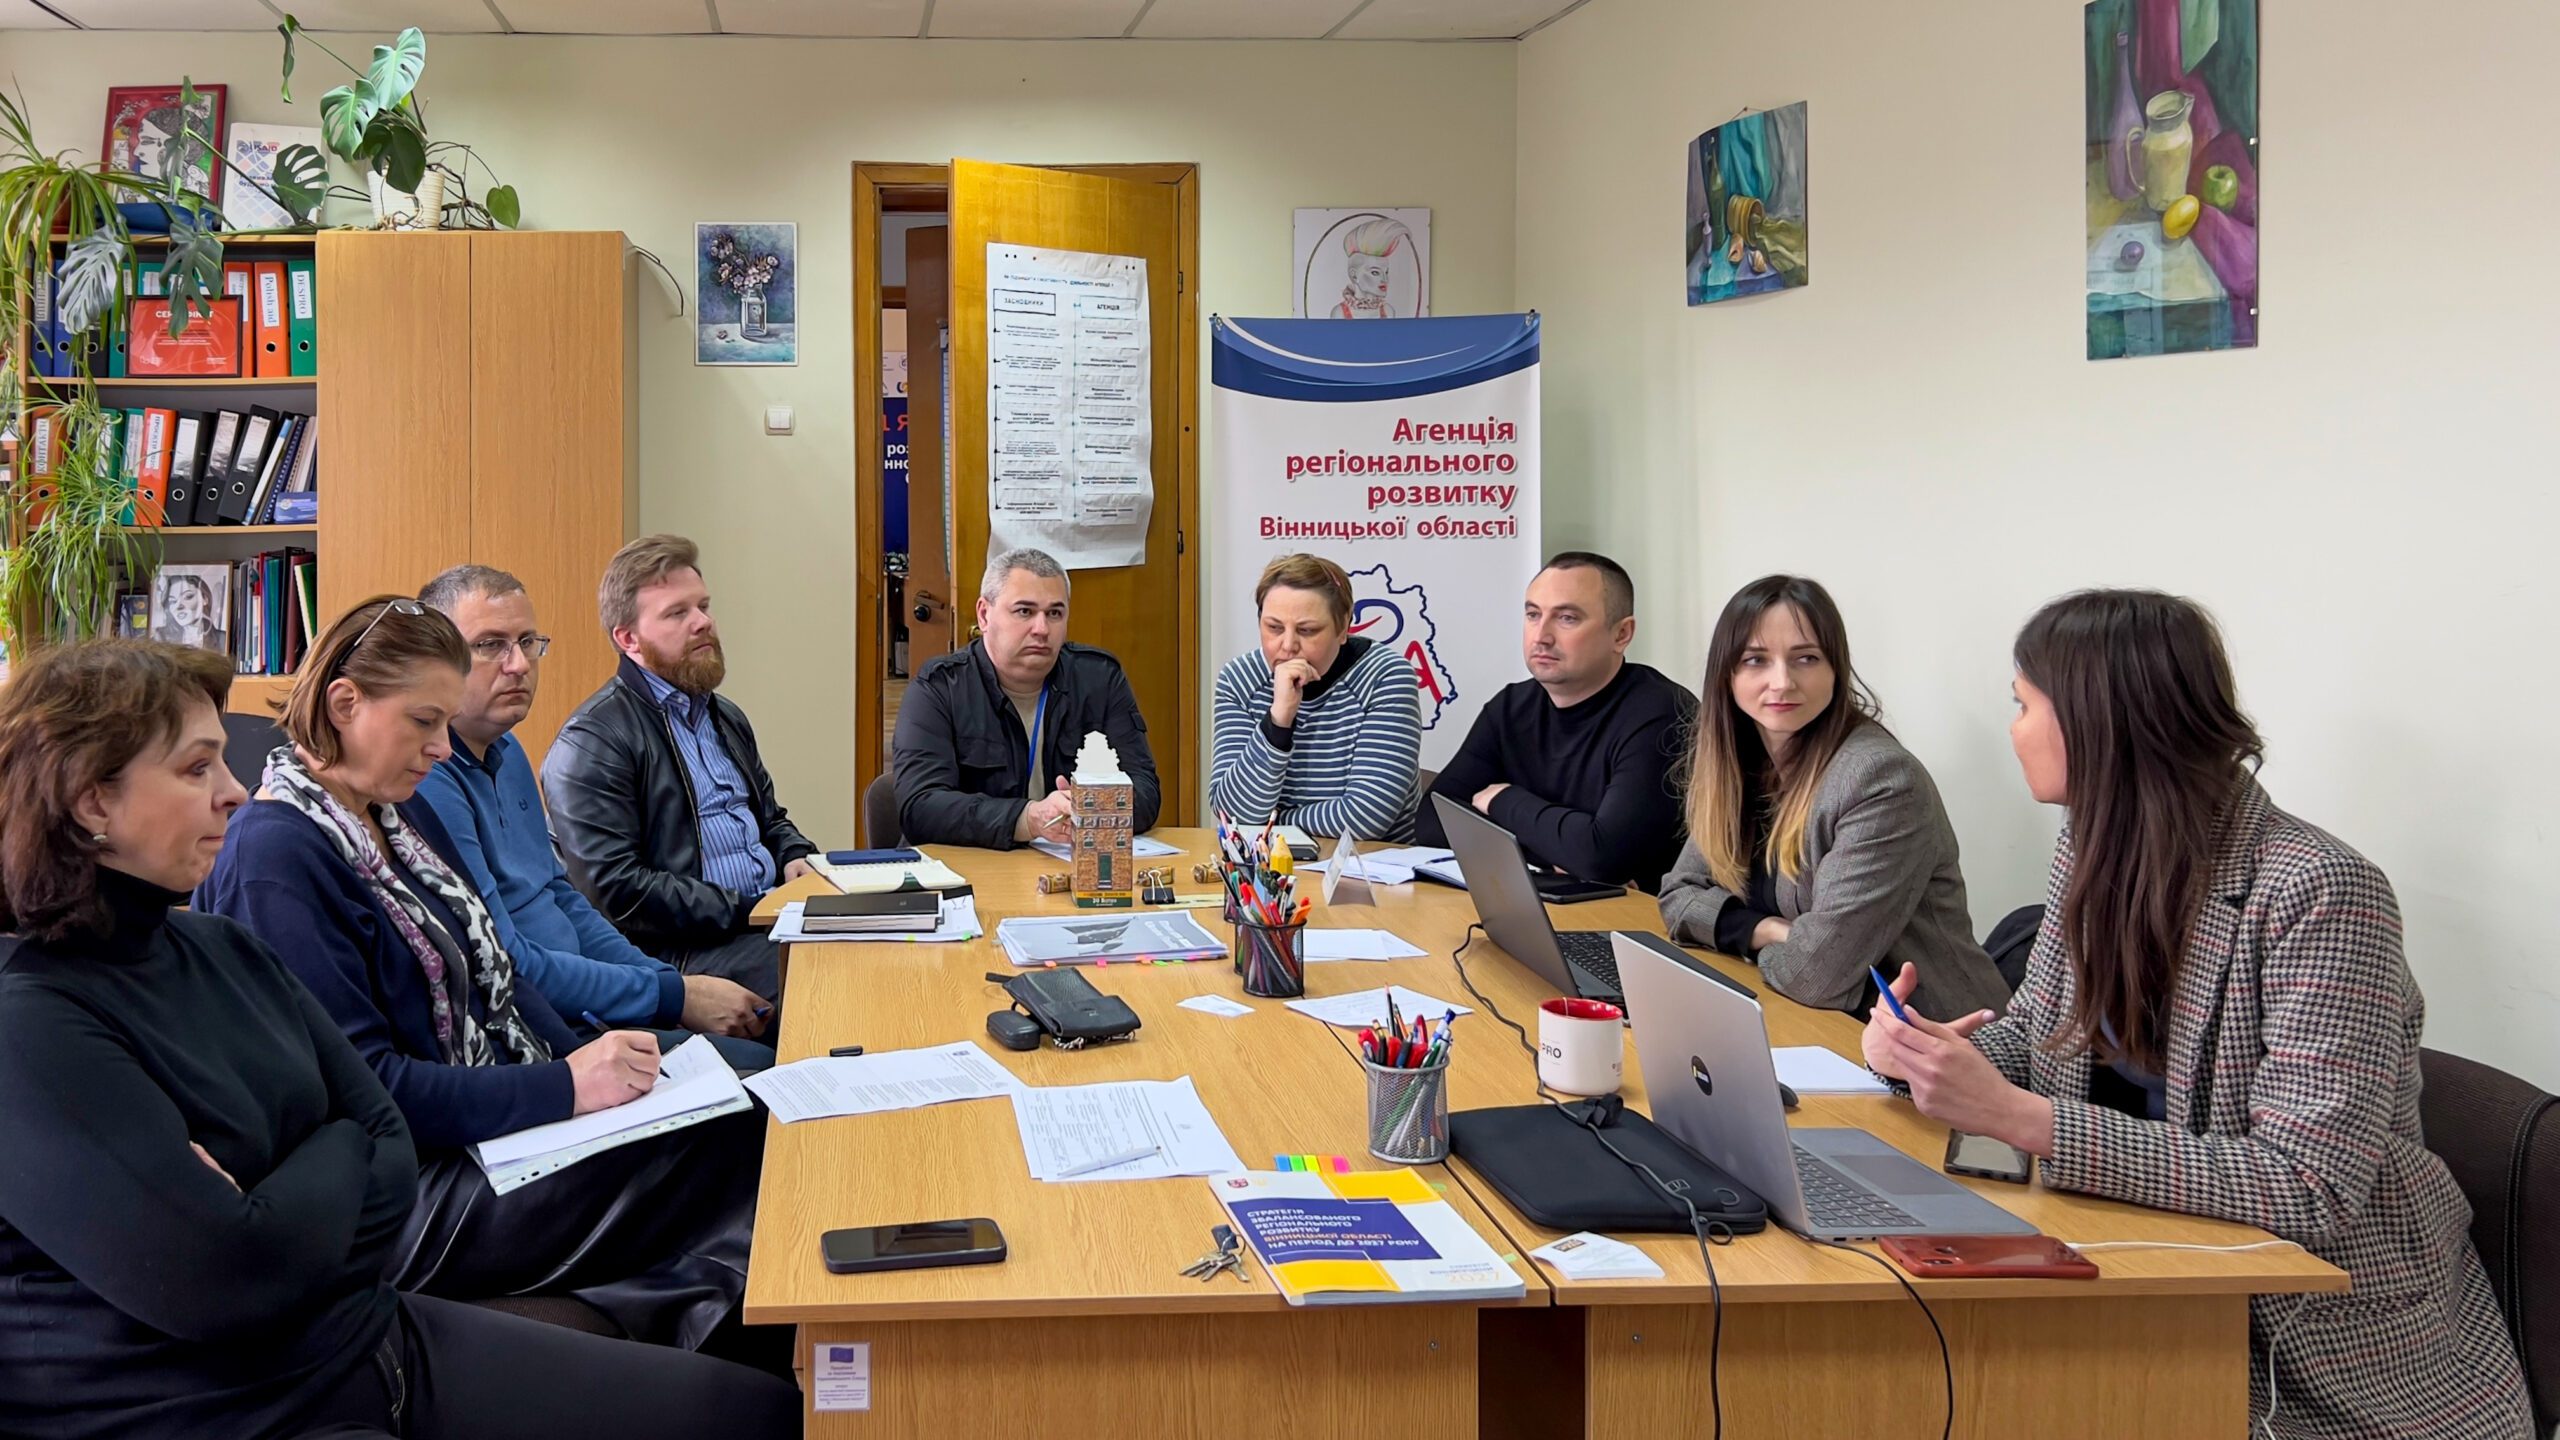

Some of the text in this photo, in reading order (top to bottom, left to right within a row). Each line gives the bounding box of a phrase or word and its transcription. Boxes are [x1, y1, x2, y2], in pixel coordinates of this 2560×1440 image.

[265, 277, 277, 323] Polish aid
[296, 274, 307, 315] DESPRO
[1392, 416, 1515, 446] Агенція
[1286, 449, 1515, 480] регіонального
[1367, 485, 1516, 510] розвитку
[1260, 515, 1515, 541] Вінницької області
[1247, 1208, 1305, 1218] СТРАТЕГІЯ
[1251, 1214, 1362, 1224] ЗБАЛАНСОВАНОГО
[1255, 1220, 1353, 1230] РЕГІОНАЛЬНОГО
[1259, 1227, 1320, 1237] РОЗВИТКУ
[1264, 1232, 1338, 1242] ВІННИЦЬКОЇ
